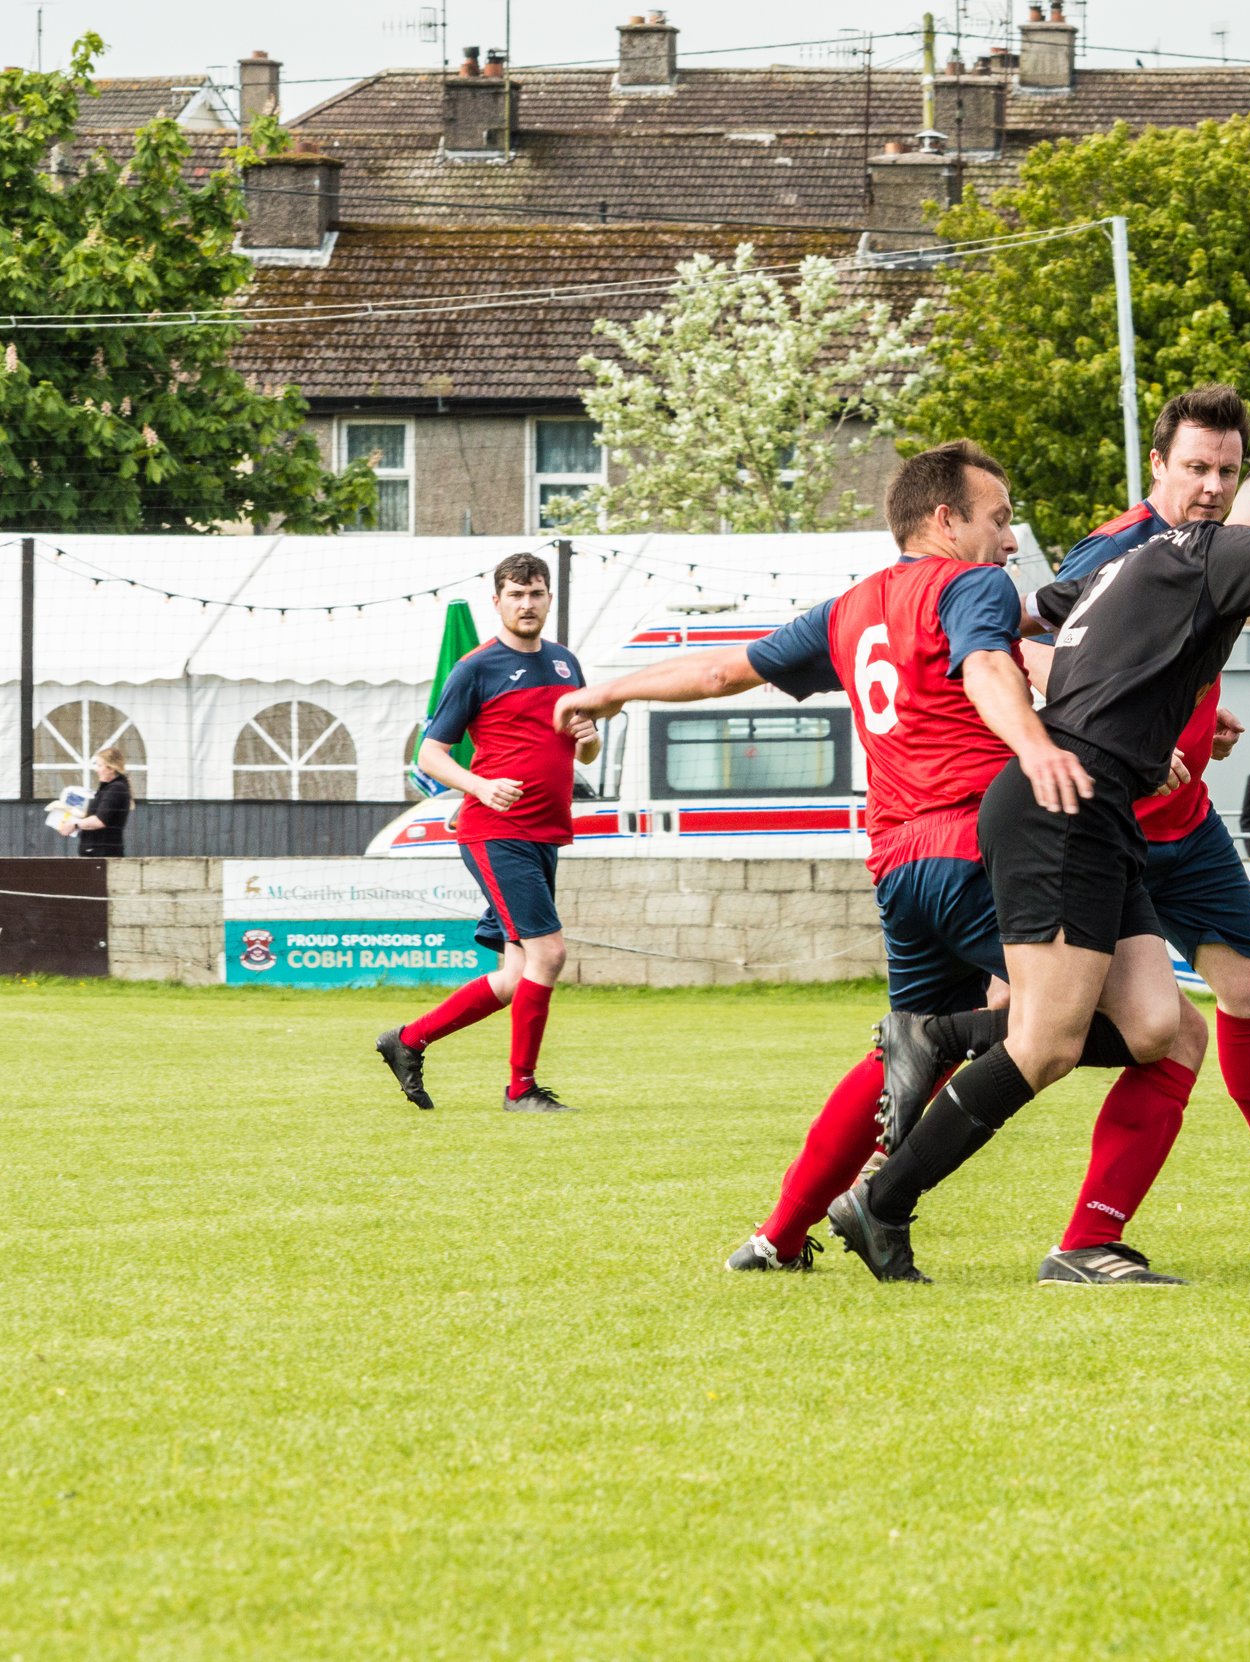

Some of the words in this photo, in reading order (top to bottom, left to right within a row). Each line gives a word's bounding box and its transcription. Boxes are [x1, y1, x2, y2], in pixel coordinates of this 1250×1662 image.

[853, 622, 900, 735] 6
[267, 885, 345, 901] McCarthy
[350, 885, 427, 901] Insurance
[433, 885, 484, 903] Group
[287, 934, 338, 947] PROUD
[341, 934, 421, 947] SPONSORS
[424, 933, 446, 946] OF
[287, 950, 354, 968] COBH
[359, 950, 479, 968] RAMBLERS
